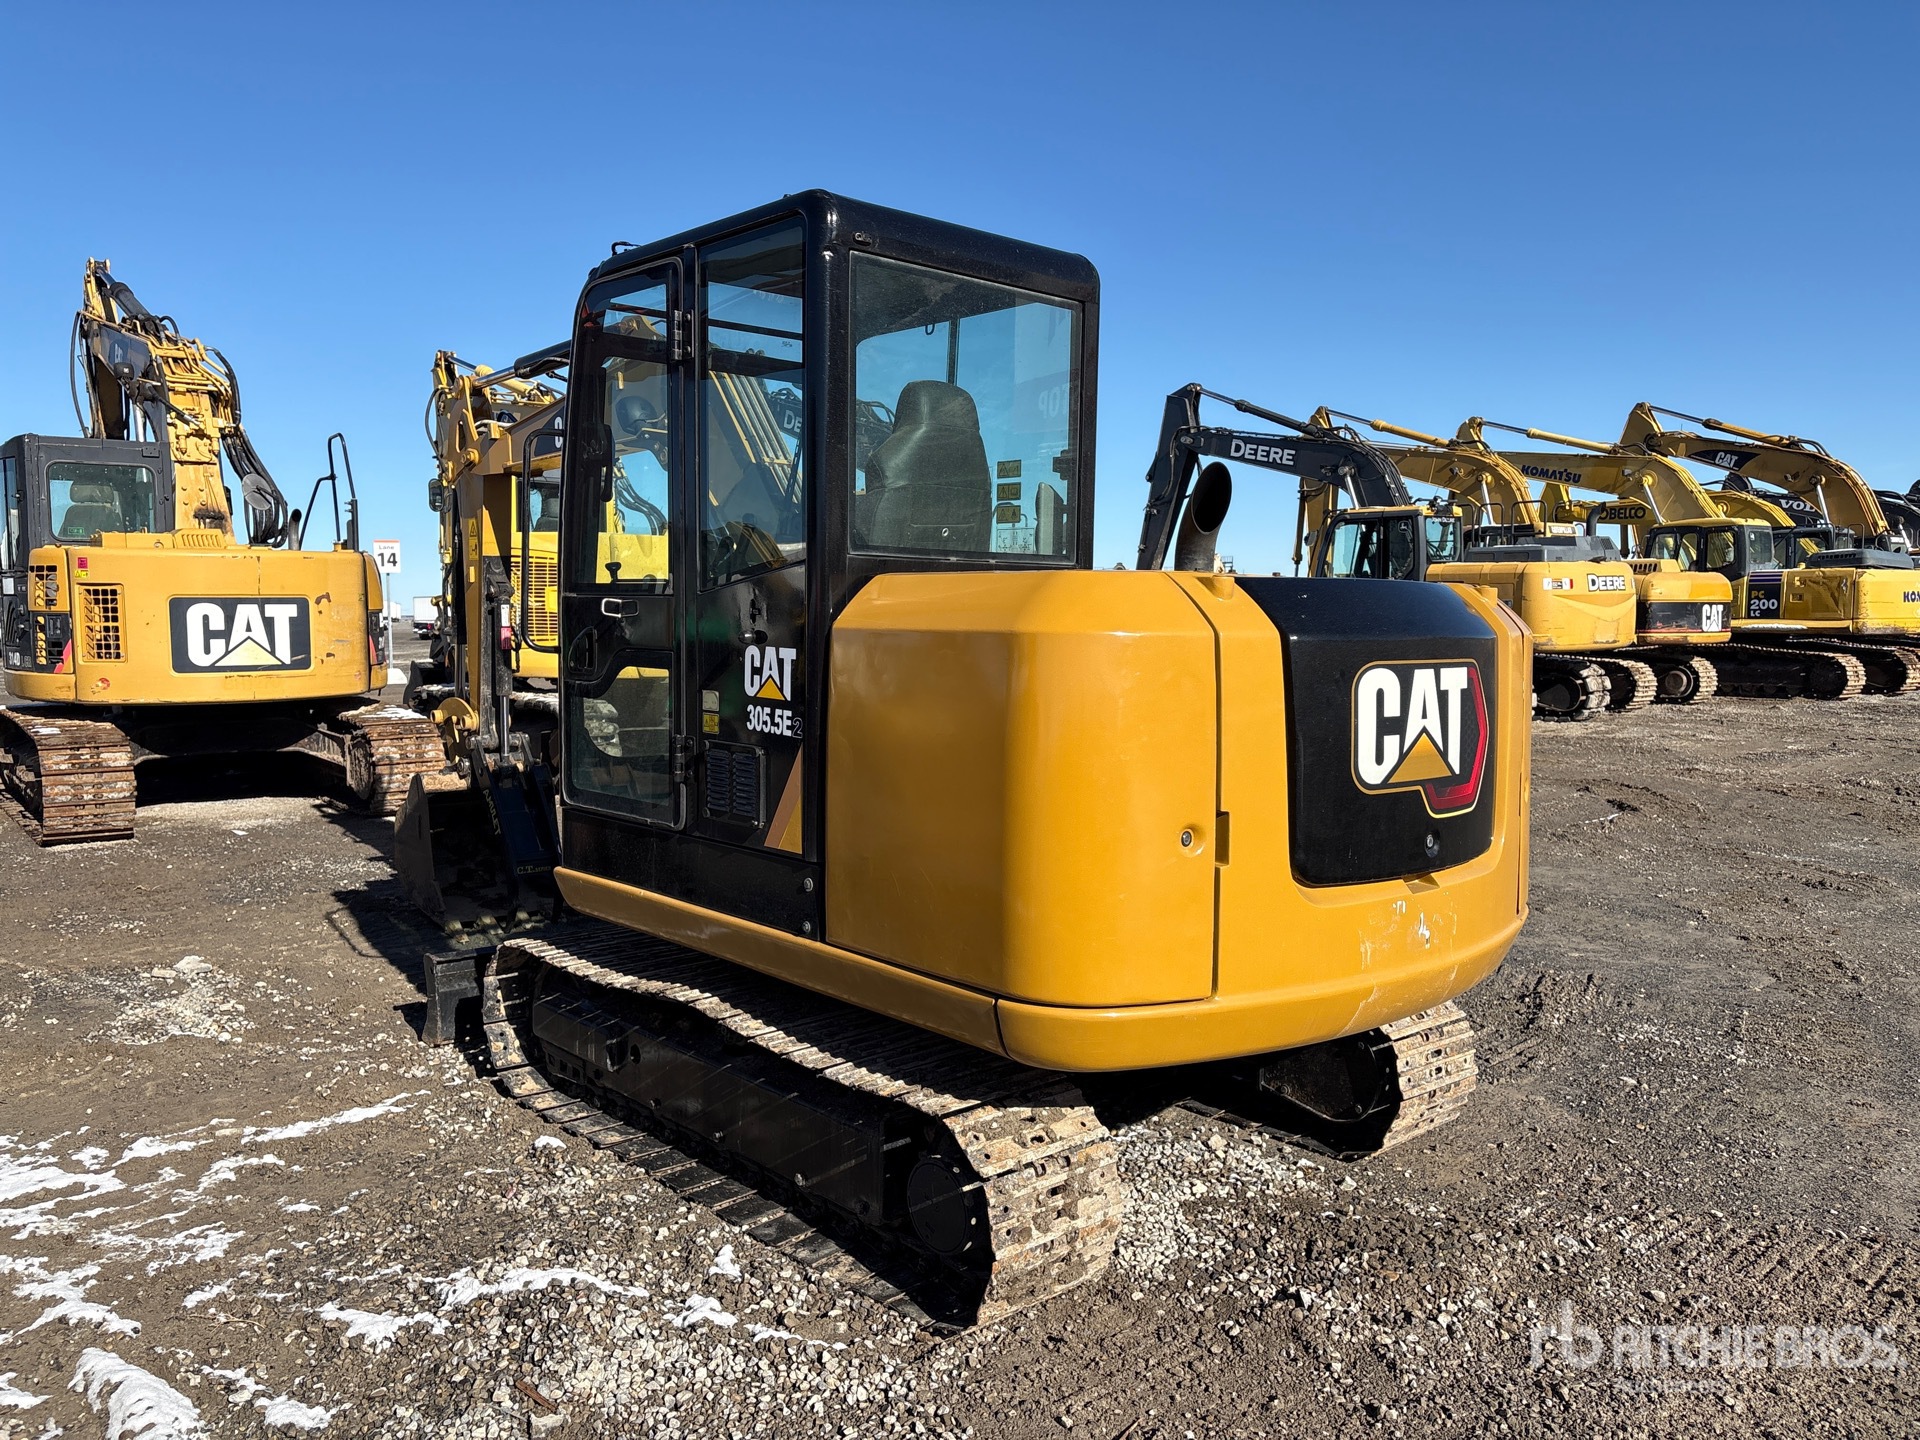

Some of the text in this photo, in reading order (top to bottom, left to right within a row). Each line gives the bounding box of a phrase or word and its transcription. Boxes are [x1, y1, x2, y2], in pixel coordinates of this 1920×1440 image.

[1230, 438, 1296, 466] DEERE
[1715, 451, 1739, 468] CAT
[1521, 464, 1582, 484] KOMATSU
[1600, 506, 1647, 520] OBELCO
[1779, 499, 1816, 512] VOL
[377, 552, 398, 567] 14
[1587, 573, 1626, 592] DEERE
[1750, 599, 1778, 610] 200
[1702, 604, 1724, 632] CAT
[186, 602, 297, 667] CAT
[744, 645, 797, 701] CAT
[746, 704, 803, 739] 305.5E2
[1357, 667, 1468, 785] CAT
[482, 788, 501, 836] AMULET
